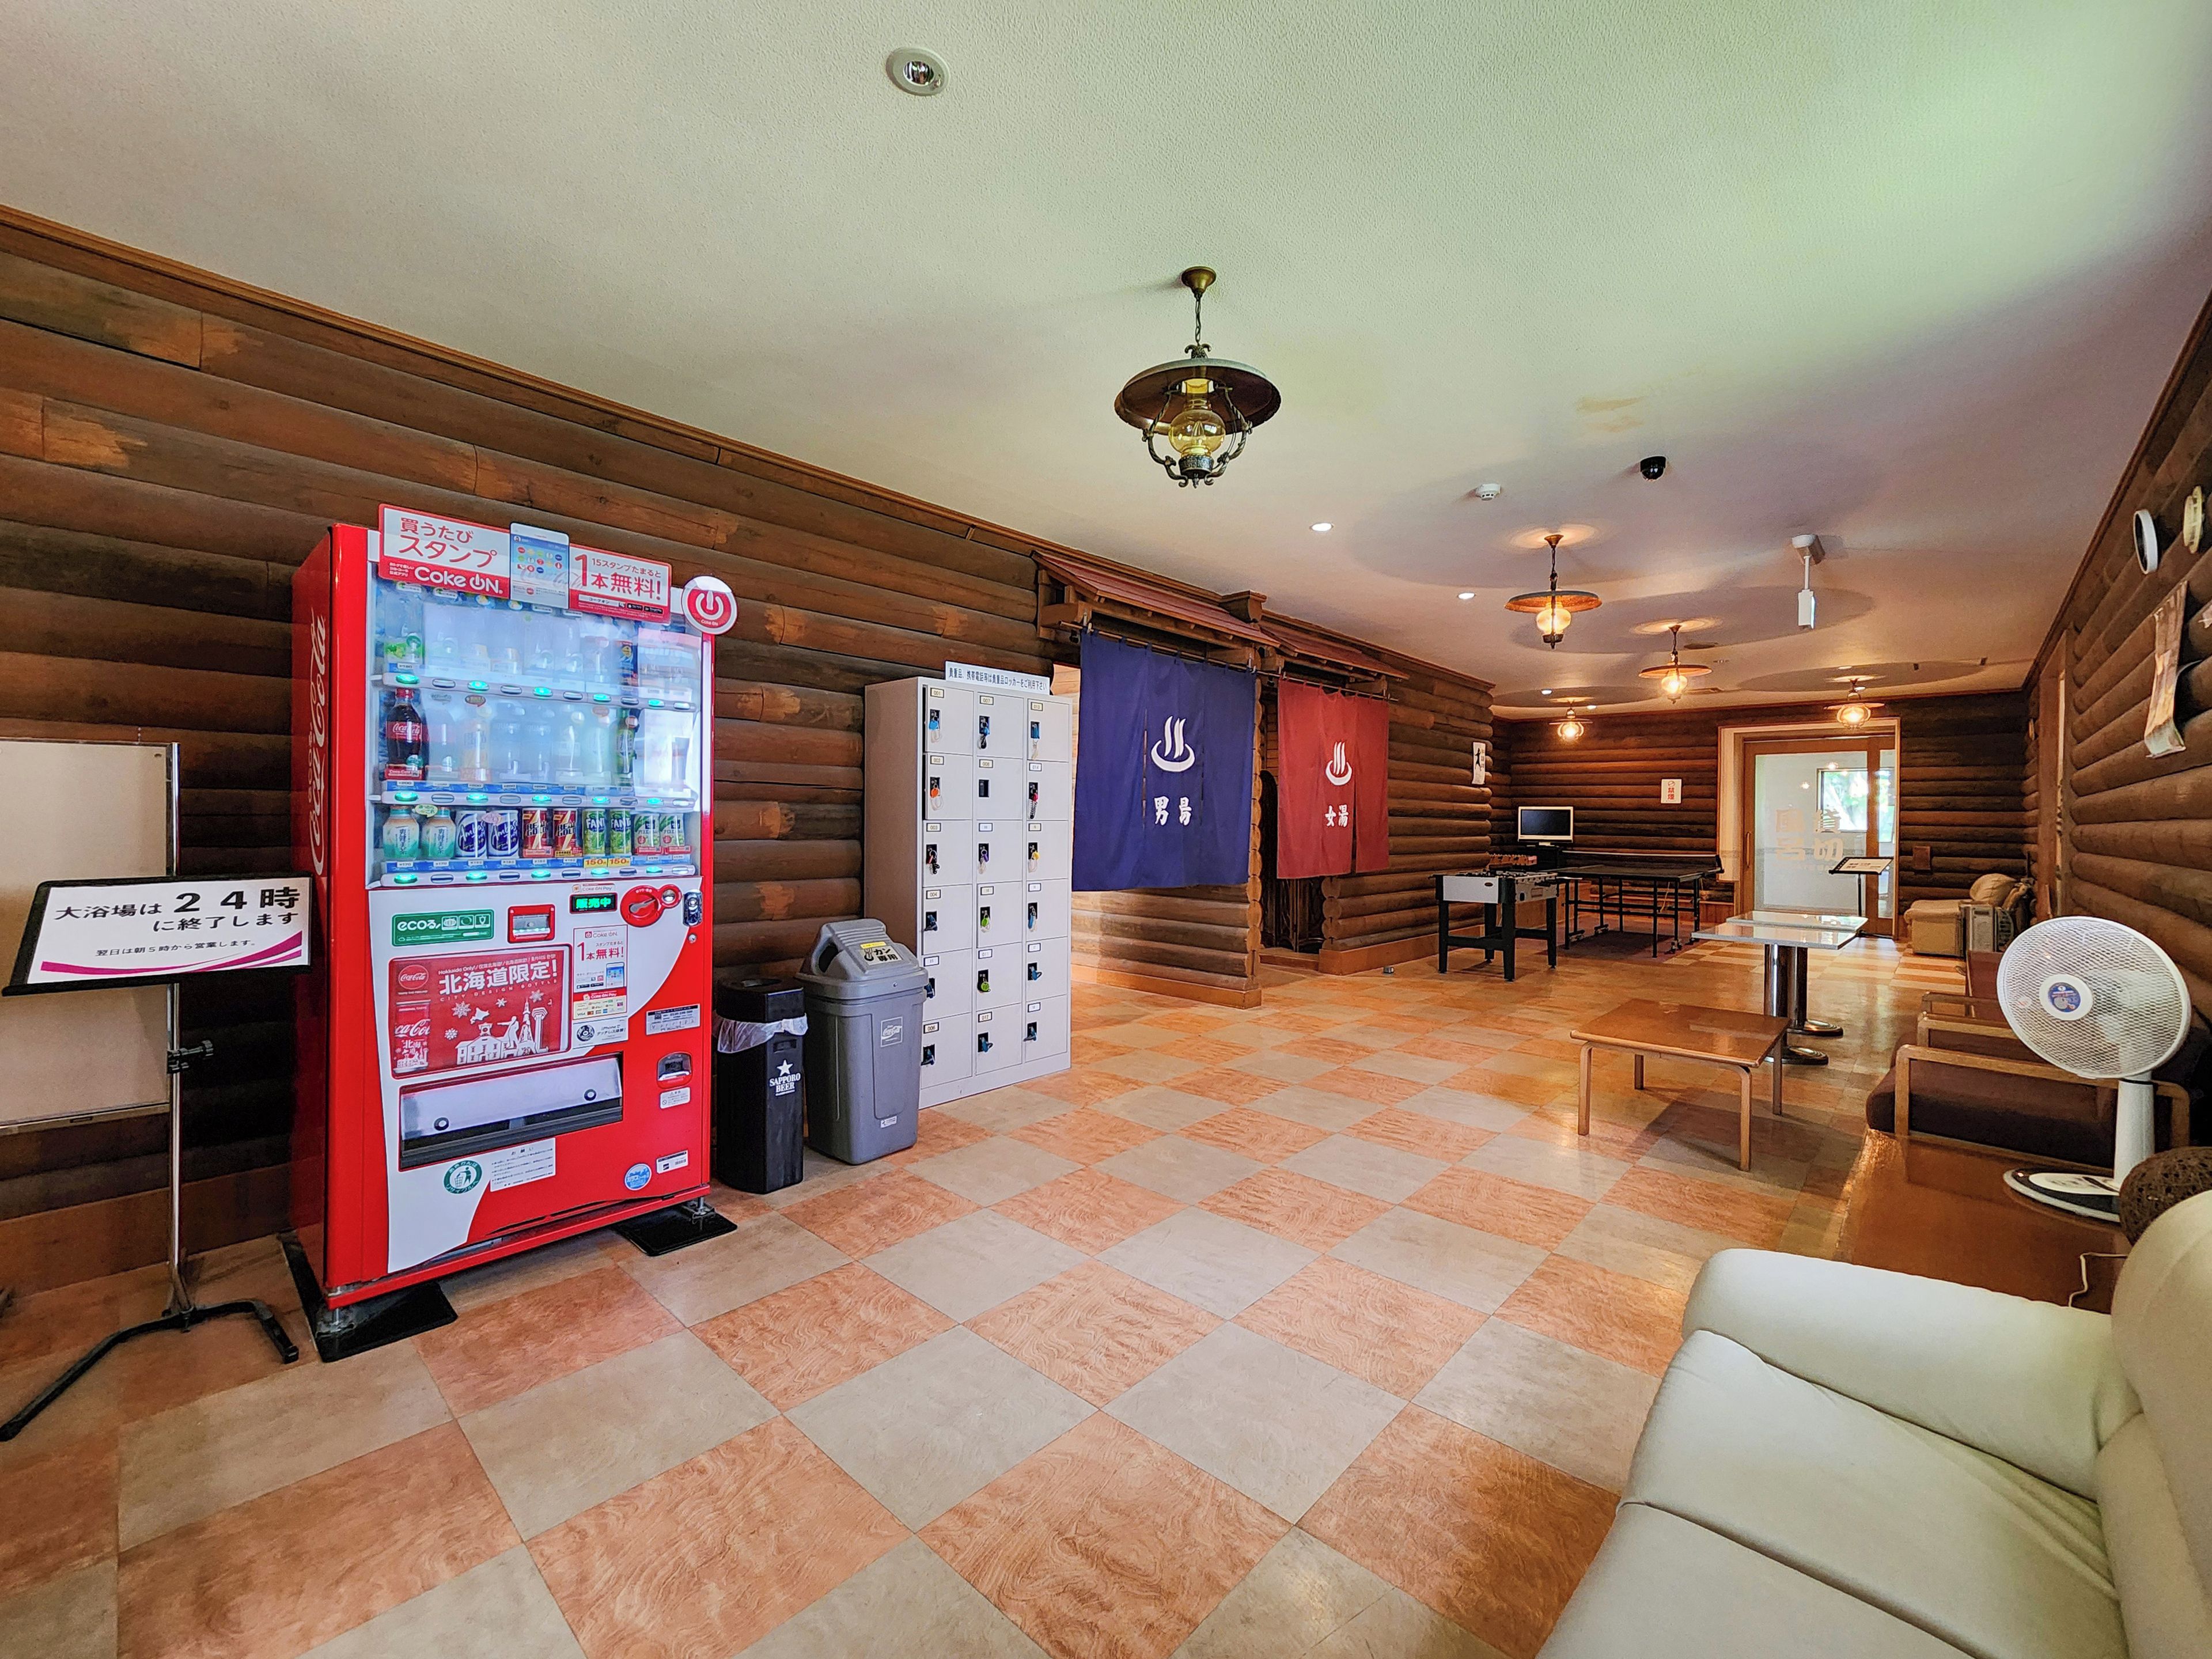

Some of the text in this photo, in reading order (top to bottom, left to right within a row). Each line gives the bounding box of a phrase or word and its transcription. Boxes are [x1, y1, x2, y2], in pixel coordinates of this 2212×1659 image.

[401, 517, 474, 543] 買うたび
[399, 535, 497, 567] スタンプ
[415, 566, 466, 587] Coke
[575, 554, 661, 601] 1本無料!
[592, 558, 661, 578] 15スタンプたまると
[309, 607, 326, 875] Coca-Cola
[1325, 804, 1349, 828] 女湯
[576, 897, 611, 908] 販売中
[153, 912, 298, 932] に終了します
[96, 940, 255, 957] 翌日は朝5時から営業します。
[577, 942, 624, 961] 1本無料!
[400, 972, 426, 982] Coca-Cola
[438, 967, 463, 975] Hokkaido
[439, 959, 558, 995] 北海道限定!
[474, 986, 514, 997] DESIGN
[521, 979, 558, 989] BOTTLE
[770, 1073, 801, 1087] SAPPORO
[775, 1082, 795, 1093] BEER
